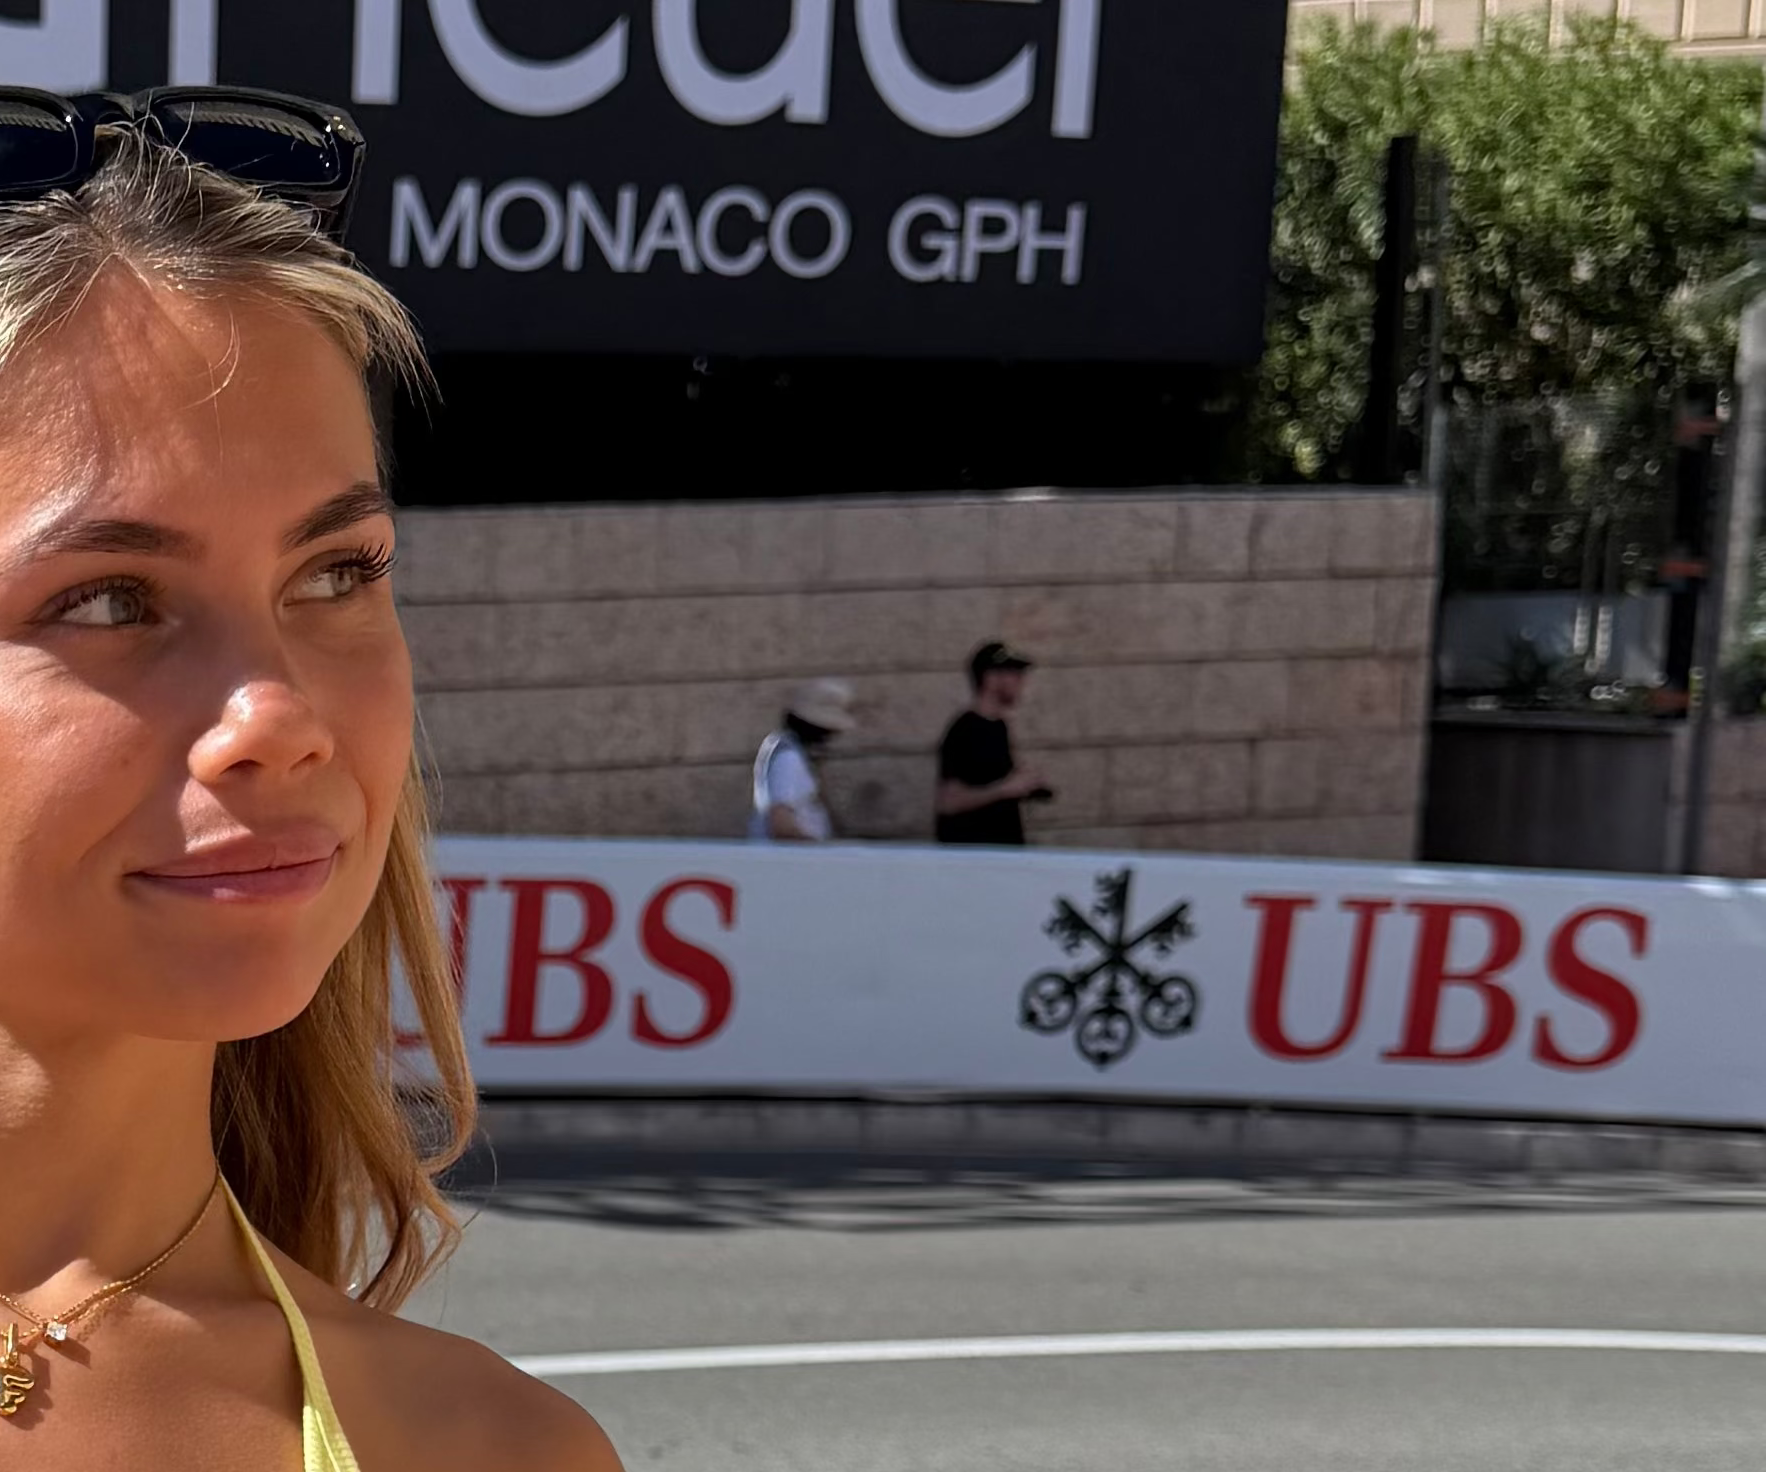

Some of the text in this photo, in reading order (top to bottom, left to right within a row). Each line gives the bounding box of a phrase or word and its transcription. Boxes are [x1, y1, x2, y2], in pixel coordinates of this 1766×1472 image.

[389, 178, 1086, 285] MONACO GPH
[1244, 894, 1652, 1071] UBS
